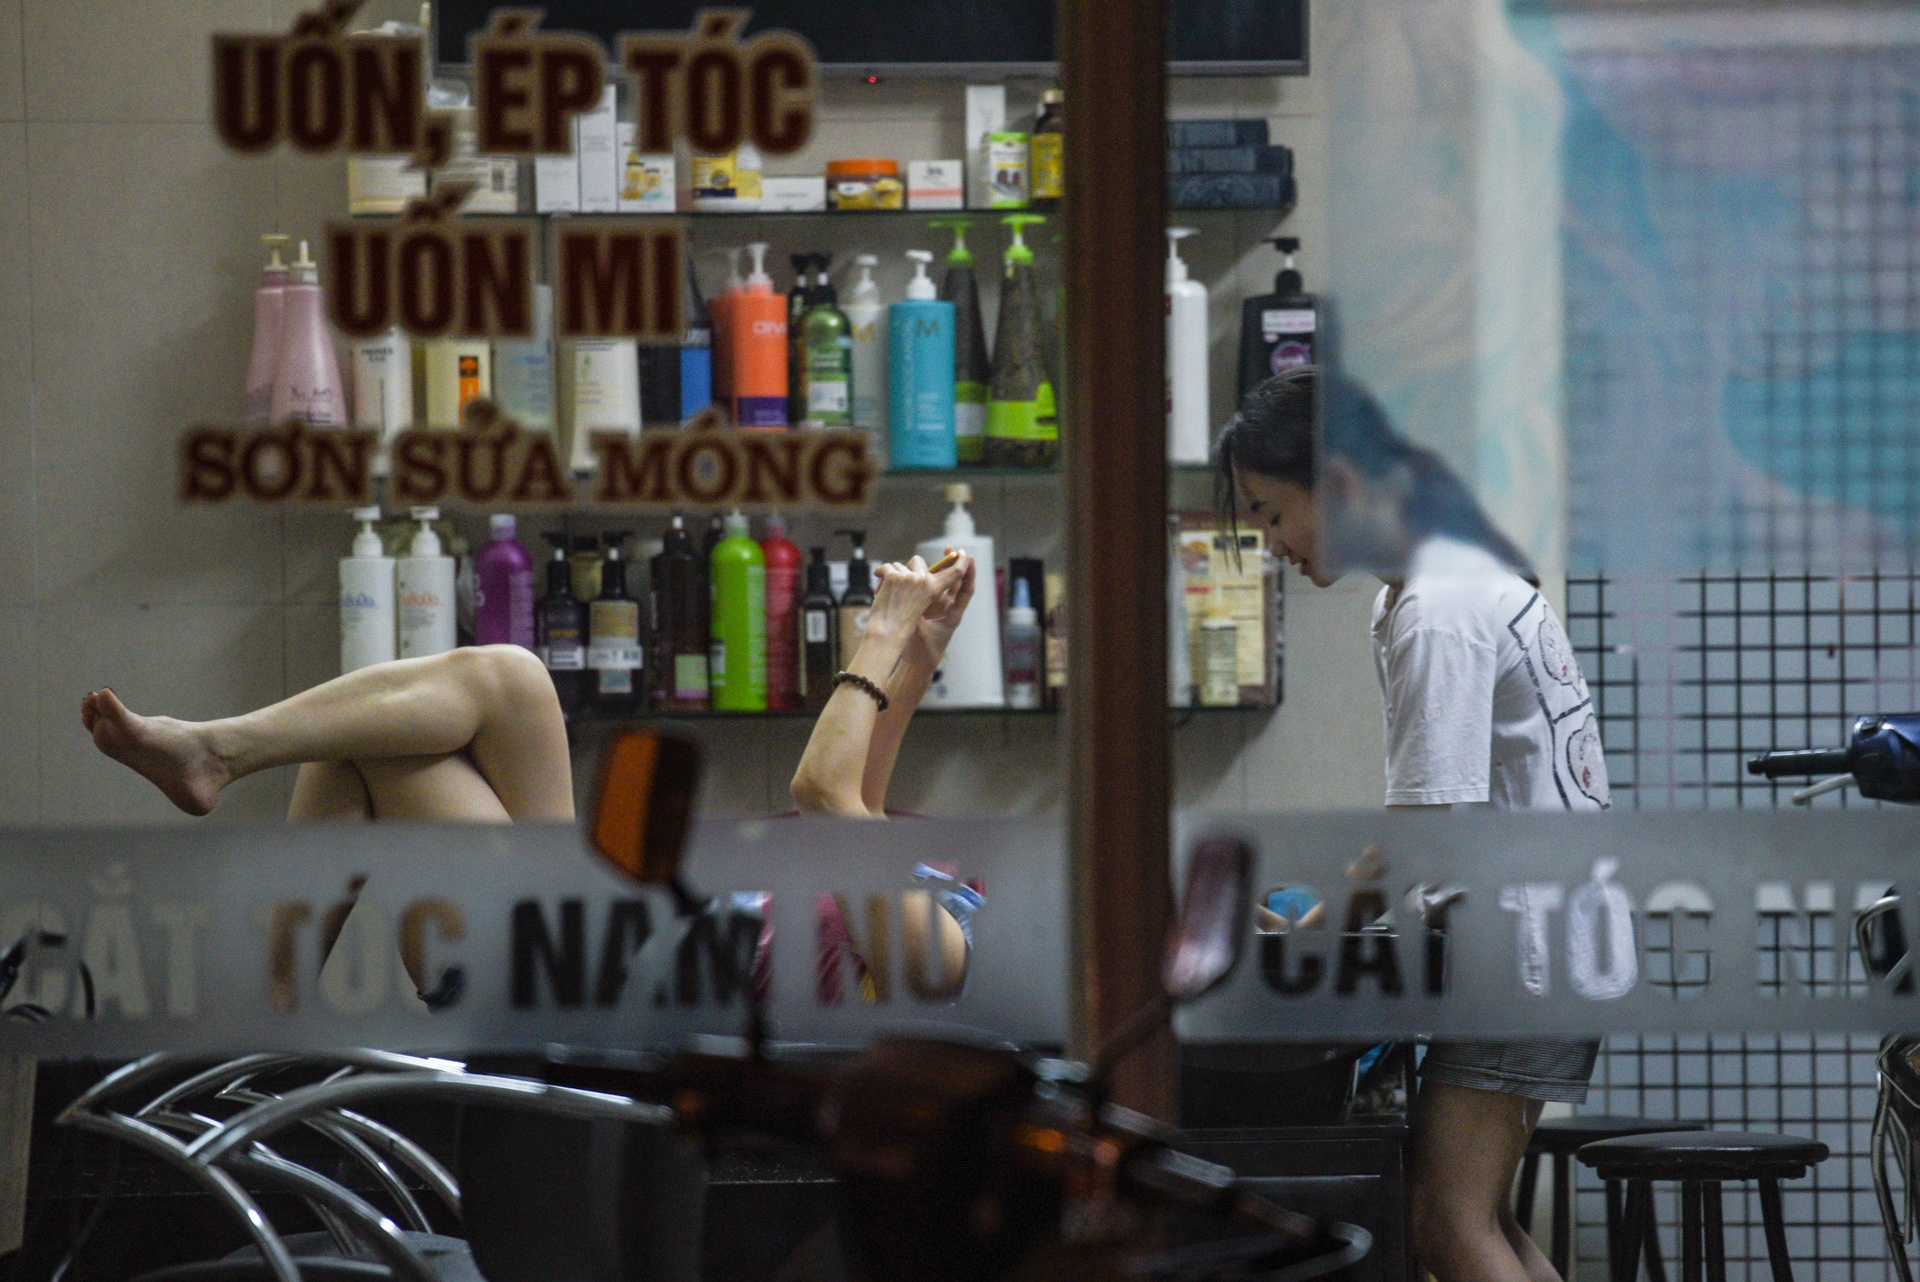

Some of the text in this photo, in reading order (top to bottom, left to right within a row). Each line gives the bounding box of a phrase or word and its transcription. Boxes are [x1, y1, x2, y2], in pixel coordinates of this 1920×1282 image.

[474, 8, 604, 154] ÉP
[619, 8, 816, 156] TÓC
[327, 184, 685, 336] UỐN MI
[180, 419, 378, 502] SƠN
[396, 397, 571, 502] SỬA
[592, 406, 875, 502] MÓNG
[252, 870, 466, 1013] TÓC
[509, 896, 775, 1010] NAM
[1500, 857, 1712, 1000] TÓC
